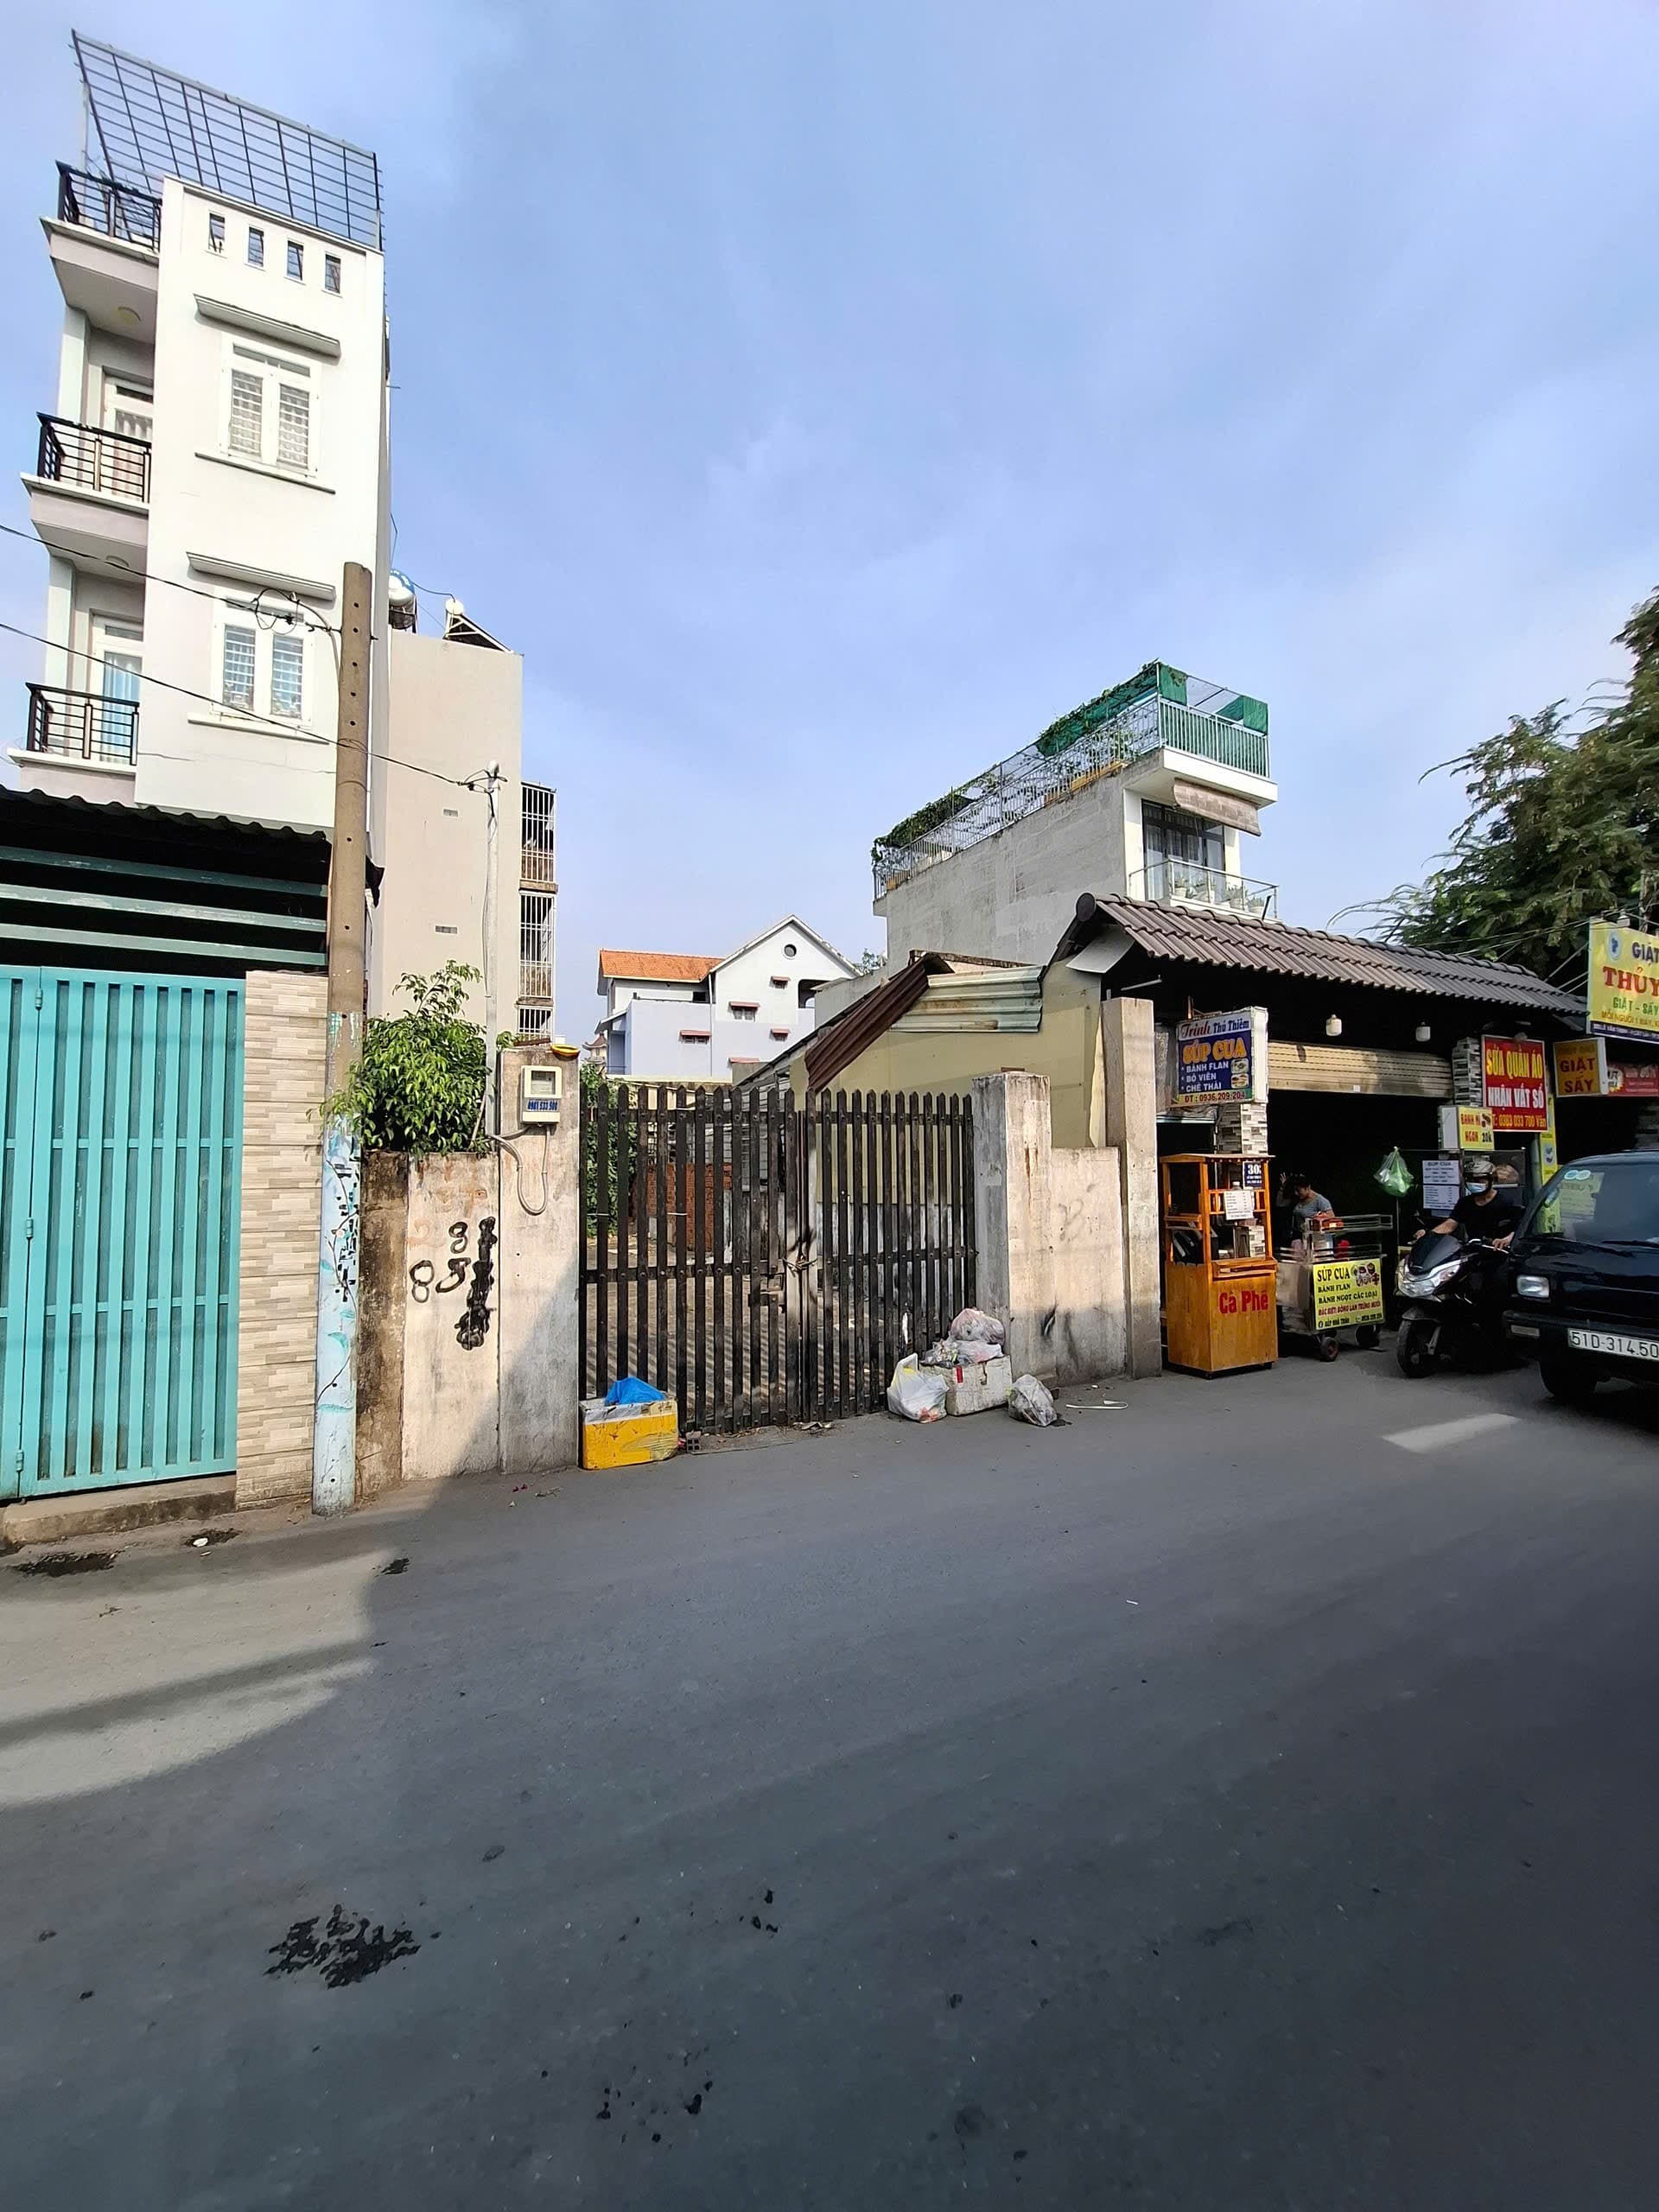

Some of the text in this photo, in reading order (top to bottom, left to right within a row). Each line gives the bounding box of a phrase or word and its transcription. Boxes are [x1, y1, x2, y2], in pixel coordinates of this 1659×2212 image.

[1212, 1037, 1247, 1060] CUA
[1209, 1060, 1229, 1070] FLAN
[1317, 1266, 1351, 1282] SÚP CUA
[1219, 1289, 1269, 1313] Cà Phê
